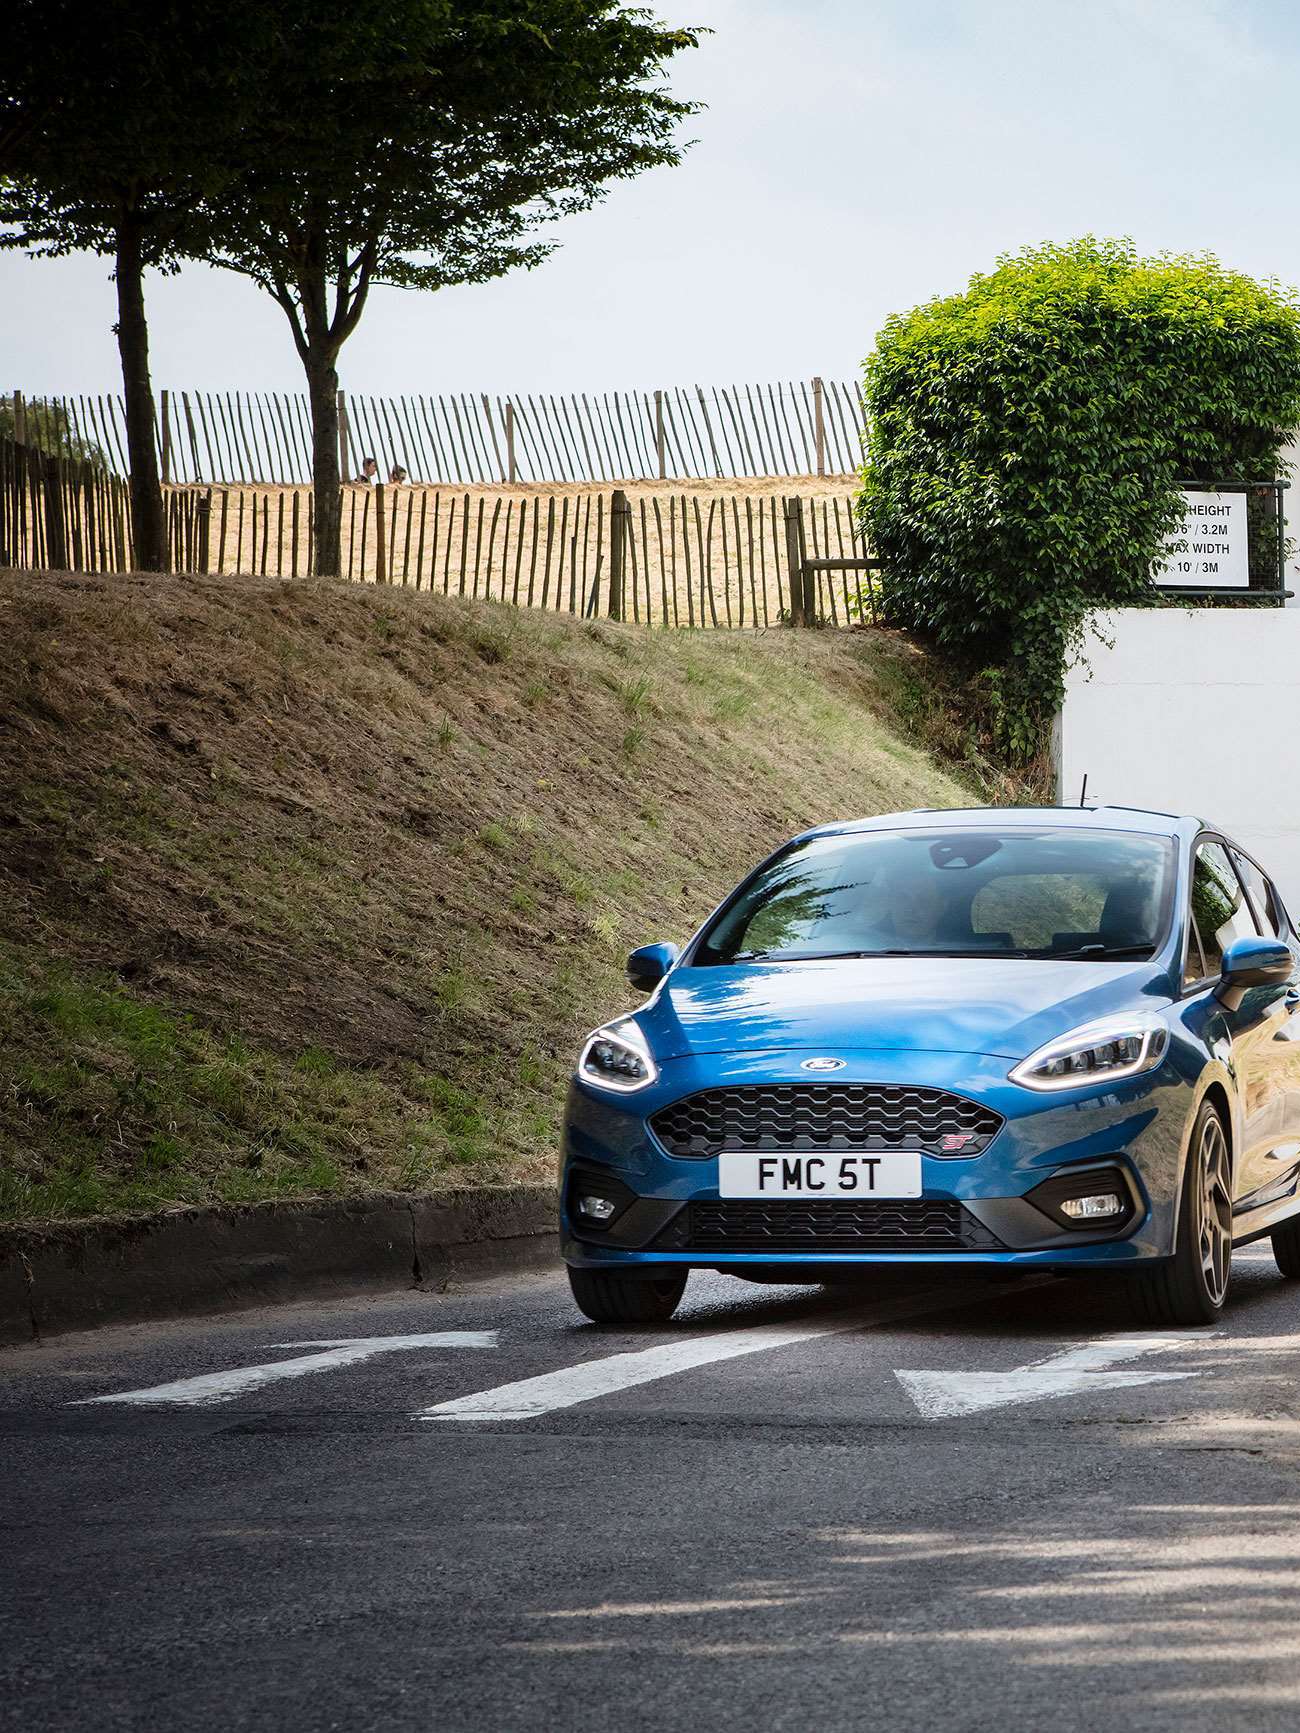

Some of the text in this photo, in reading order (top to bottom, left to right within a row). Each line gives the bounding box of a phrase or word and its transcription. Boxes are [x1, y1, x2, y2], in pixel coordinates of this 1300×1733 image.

[1189, 505, 1232, 517] HEIGHT
[1201, 524, 1228, 535] 3.2M
[1192, 543, 1230, 555] WIDTH
[1201, 562, 1219, 573] 3M
[758, 1158, 882, 1191] FMC 5T
